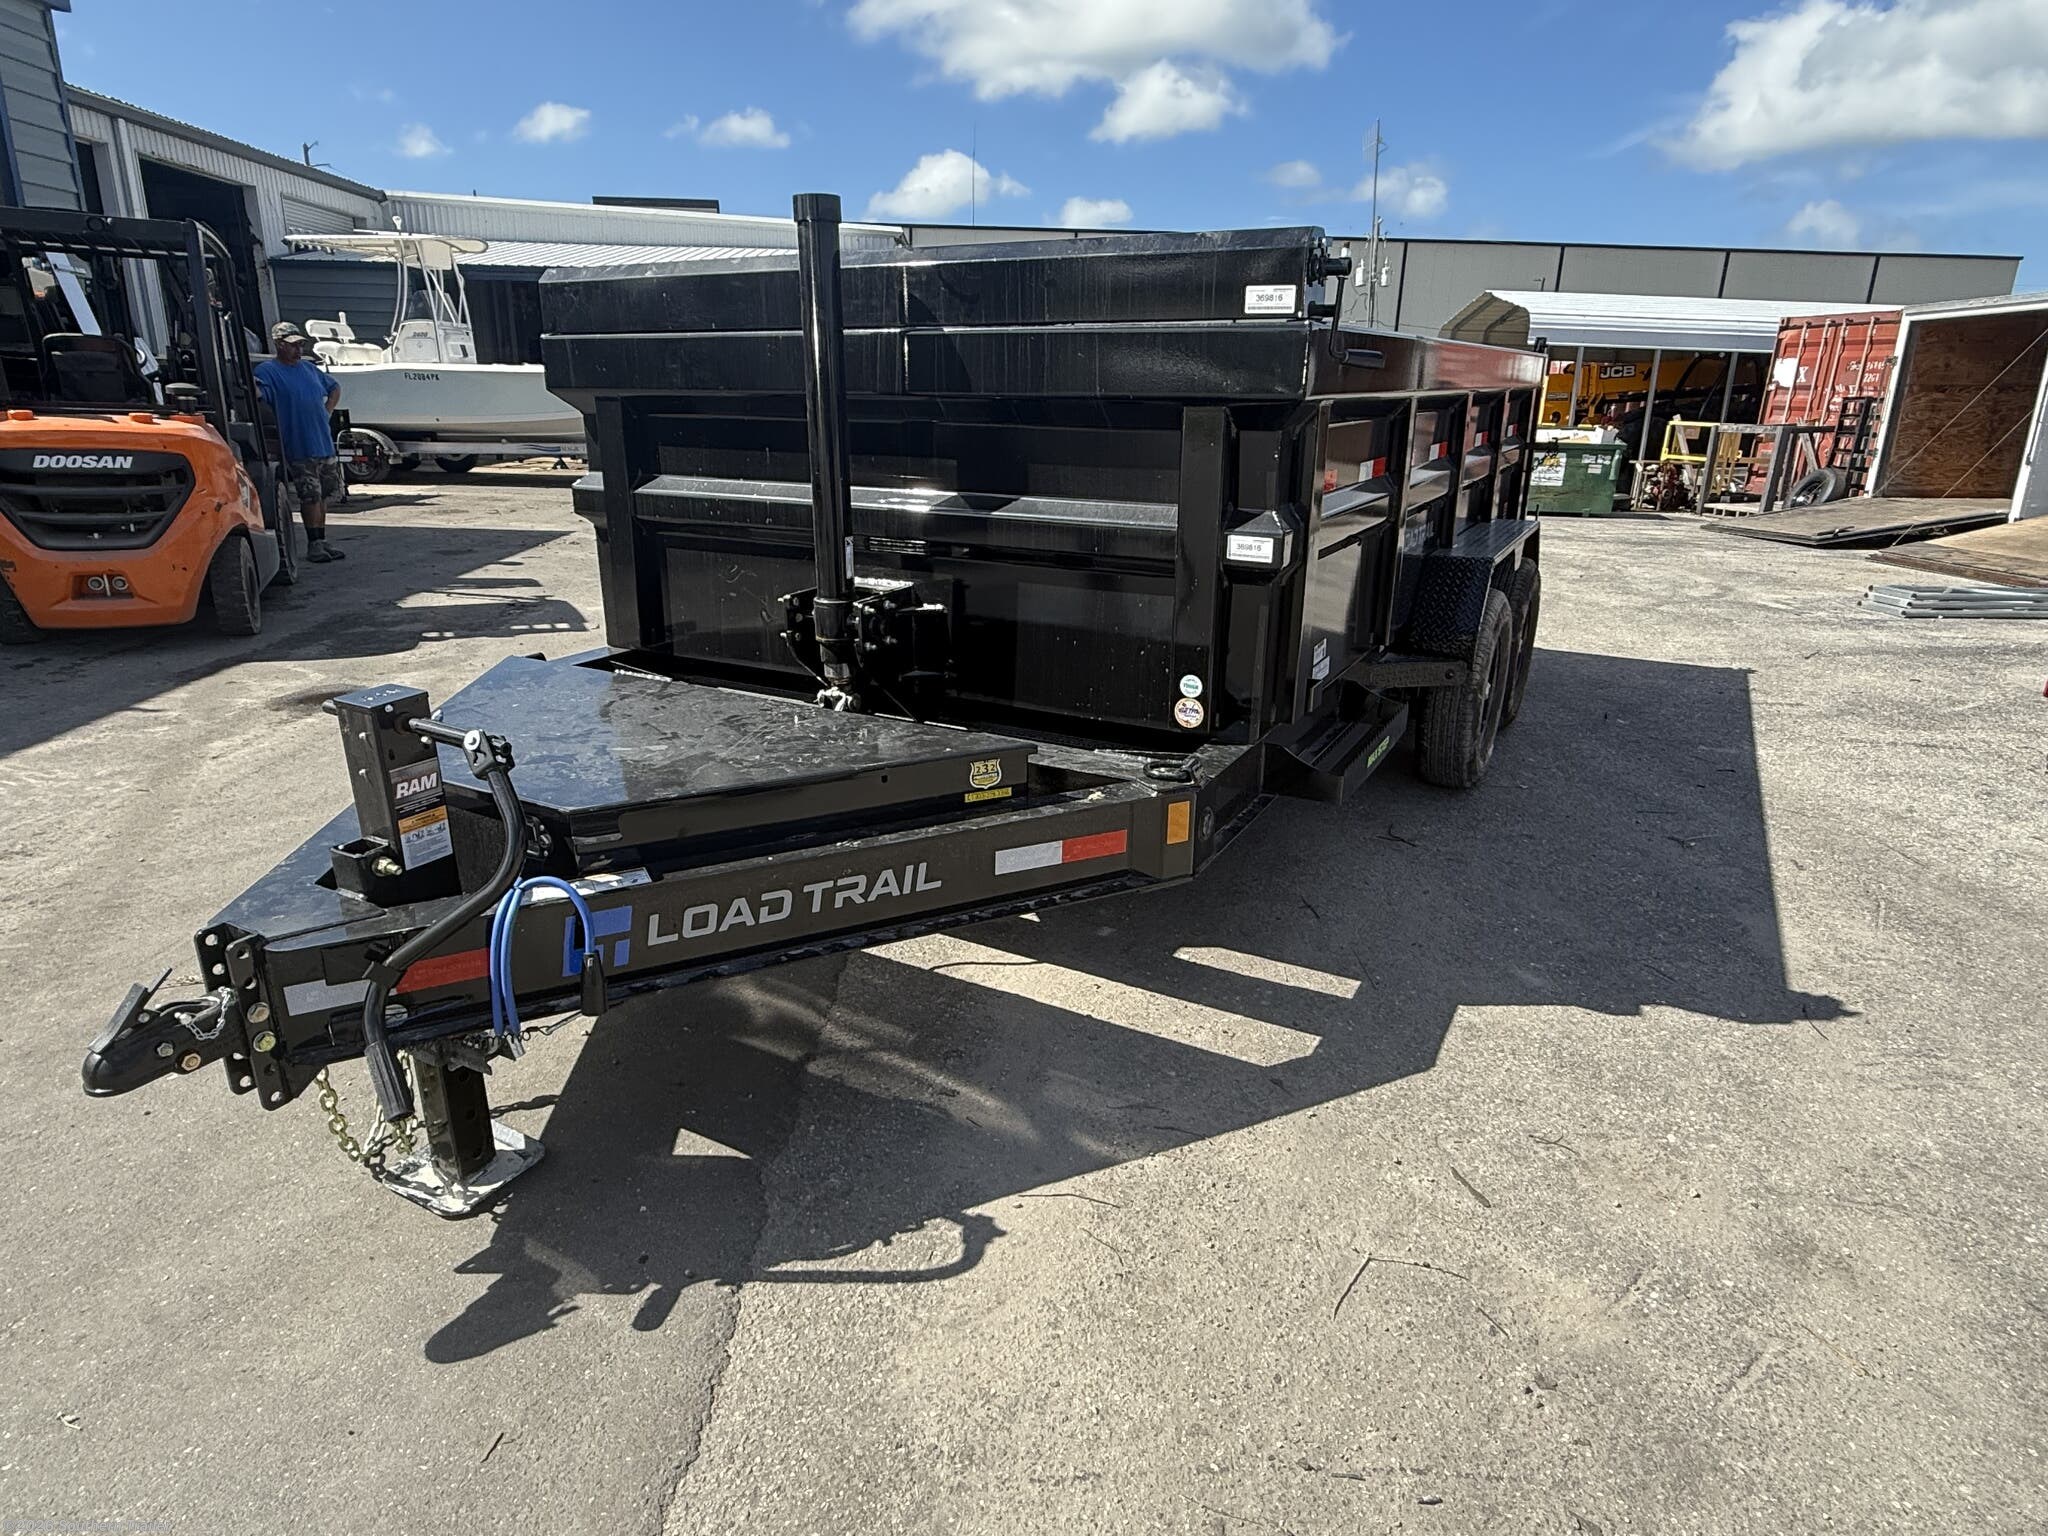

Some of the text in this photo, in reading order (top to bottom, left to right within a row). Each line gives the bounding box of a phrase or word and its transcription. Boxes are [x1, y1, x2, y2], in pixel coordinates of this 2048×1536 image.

[1256, 294, 1283, 302] 369816
[1600, 365, 1636, 379] JCB
[32, 455, 133, 469] DOOSAN
[395, 772, 437, 799] RAM
[647, 890, 793, 946] LOAD
[803, 862, 942, 914] TRAIL
